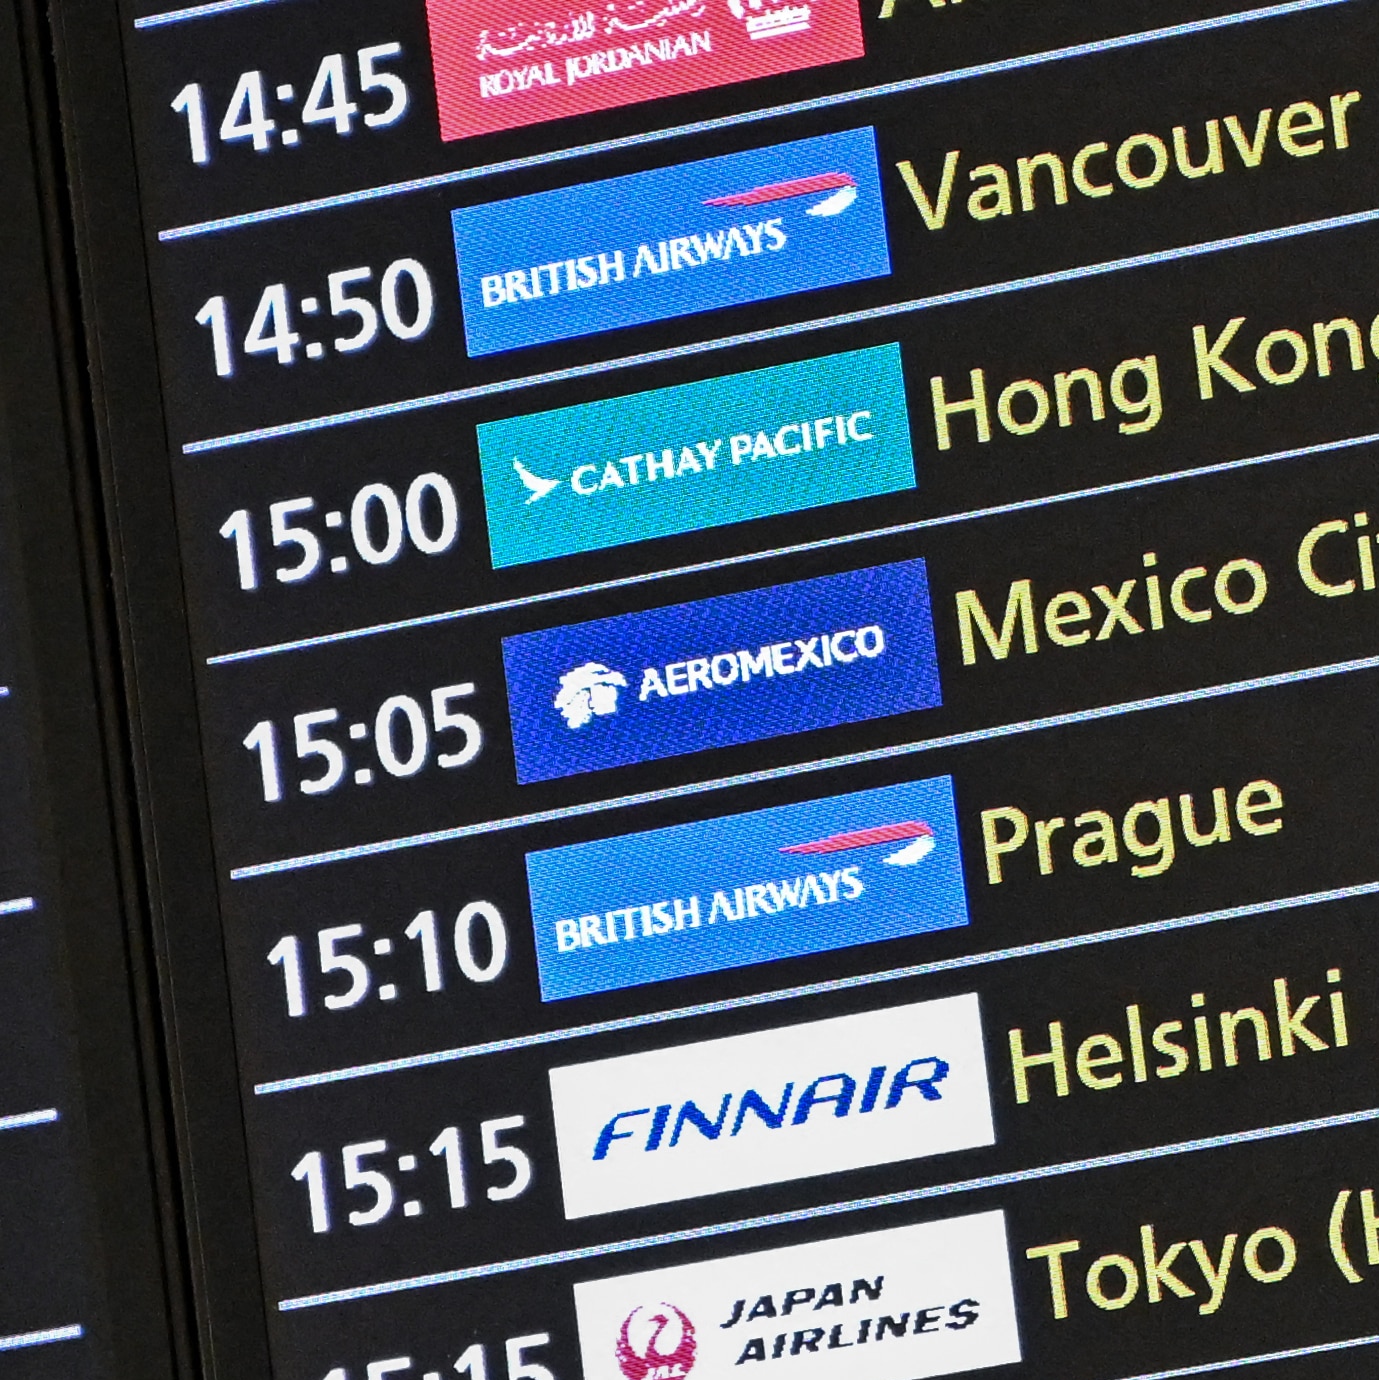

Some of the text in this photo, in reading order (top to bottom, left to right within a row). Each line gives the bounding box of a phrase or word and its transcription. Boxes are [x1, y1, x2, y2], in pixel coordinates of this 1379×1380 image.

[171, 42, 407, 162] 14:45
[479, 31, 713, 97] ROYAL JORDANIAN
[896, 91, 1361, 230] Vancouver
[482, 218, 786, 307] BRITISH AIRWAYS
[195, 258, 433, 376] 14:50
[571, 411, 873, 494] CATHAY PACIFIC
[930, 355, 1162, 450] Hong
[219, 472, 458, 590] 15:00
[956, 553, 1267, 665] Mexico
[640, 626, 884, 700] AEROMEXICO
[243, 683, 481, 802] 15:05
[981, 780, 1282, 884] Prague
[267, 900, 507, 1016] 15:10
[556, 866, 864, 952] BRITISH AIRWAYS
[1009, 969, 1348, 1103] Helsinki
[593, 1057, 949, 1160] FINNAIR
[291, 1115, 531, 1233] 15:15
[720, 1276, 885, 1329] JAPAN
[1026, 1225, 1296, 1319] Tokyo
[735, 1297, 979, 1365] AIRLINES
